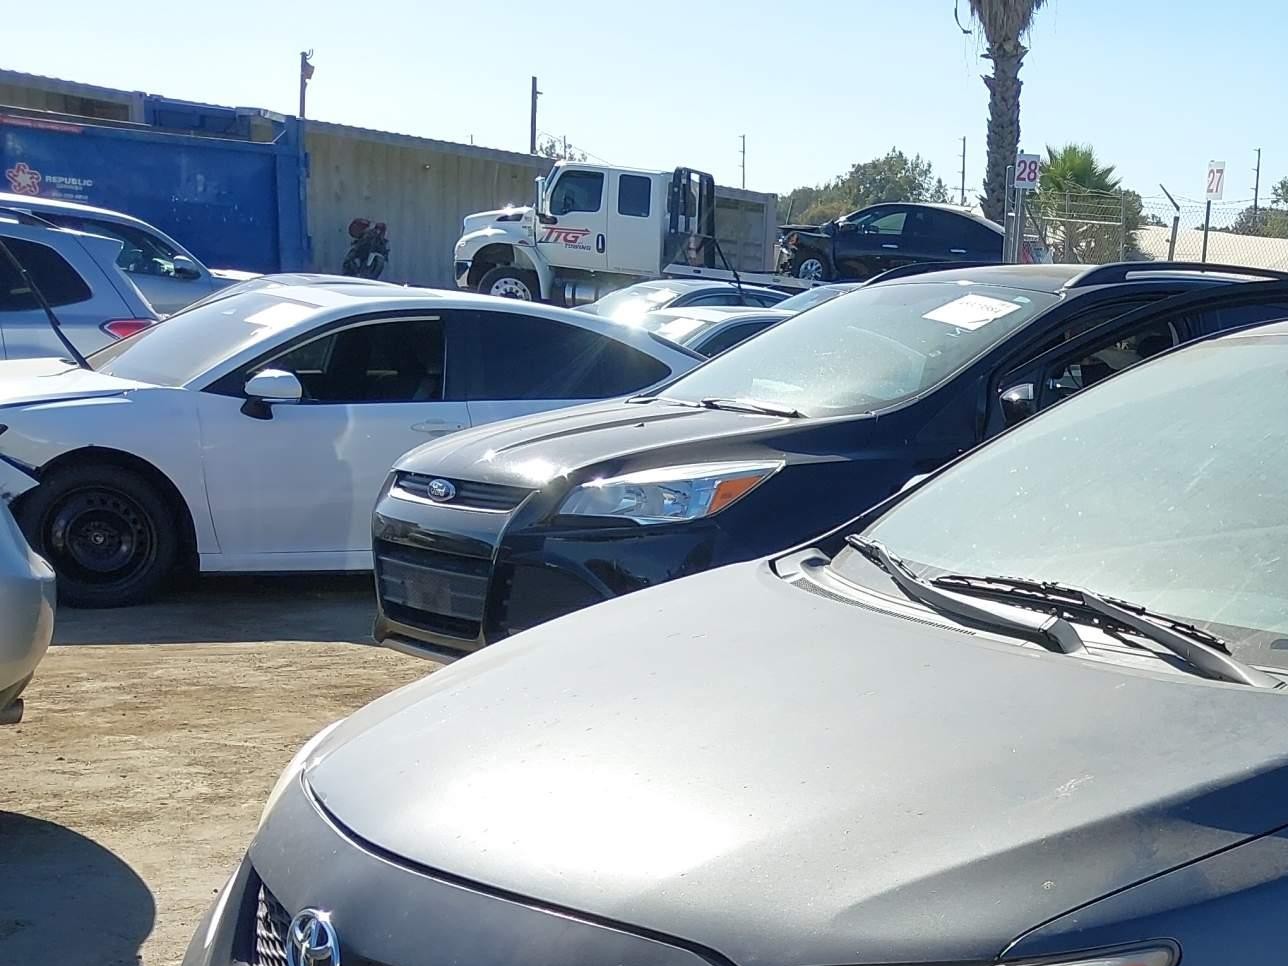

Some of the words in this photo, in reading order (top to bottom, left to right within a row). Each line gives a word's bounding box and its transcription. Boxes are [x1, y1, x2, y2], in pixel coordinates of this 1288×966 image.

[45, 175, 93, 187] REPUBLIC
[1016, 160, 1038, 182] 28
[1207, 169, 1223, 193] 27
